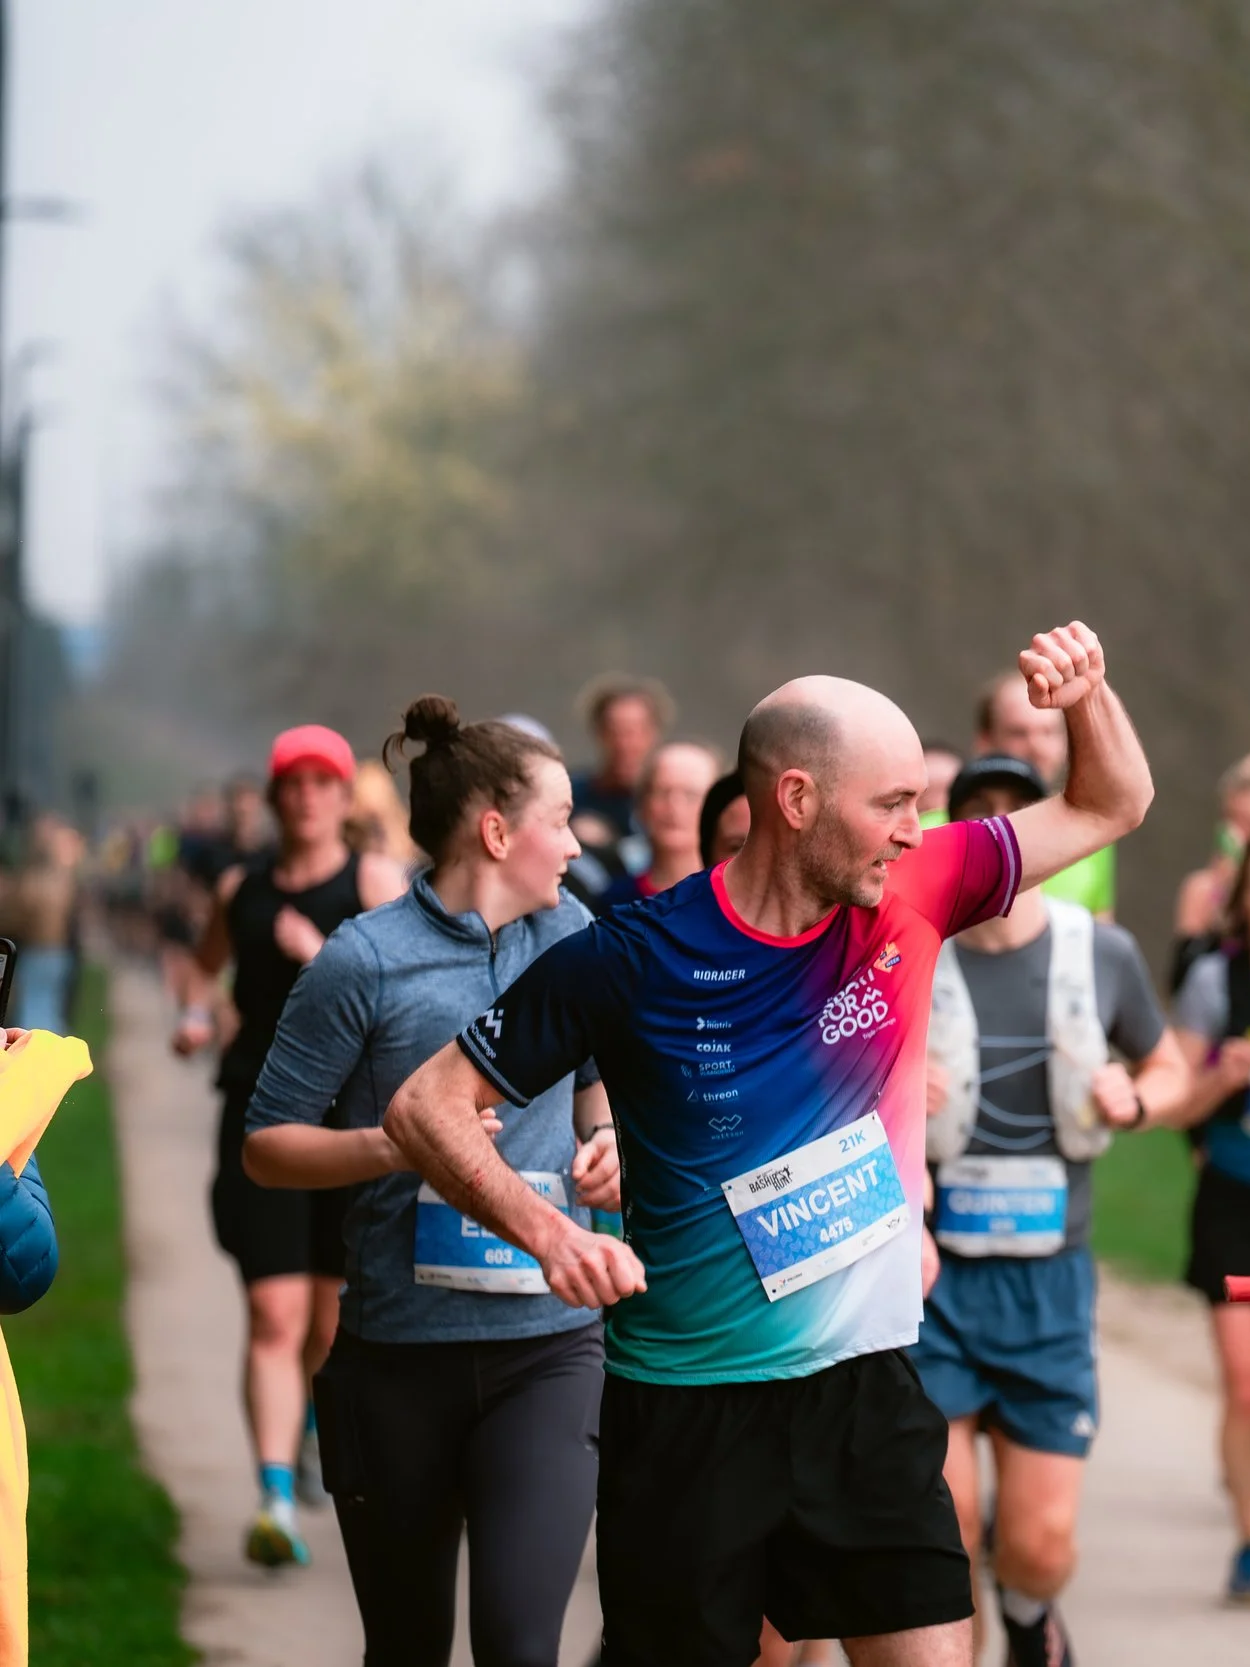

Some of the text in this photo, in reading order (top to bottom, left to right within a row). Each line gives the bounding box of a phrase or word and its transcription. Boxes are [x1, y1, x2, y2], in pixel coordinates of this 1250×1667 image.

[693, 968, 746, 982] BIORACER
[822, 1001, 888, 1045] GOOD
[702, 1089, 739, 1102] threon
[838, 1130, 867, 1153] 21K
[757, 1159, 878, 1238] VINCENT
[484, 1249, 513, 1265] 603
